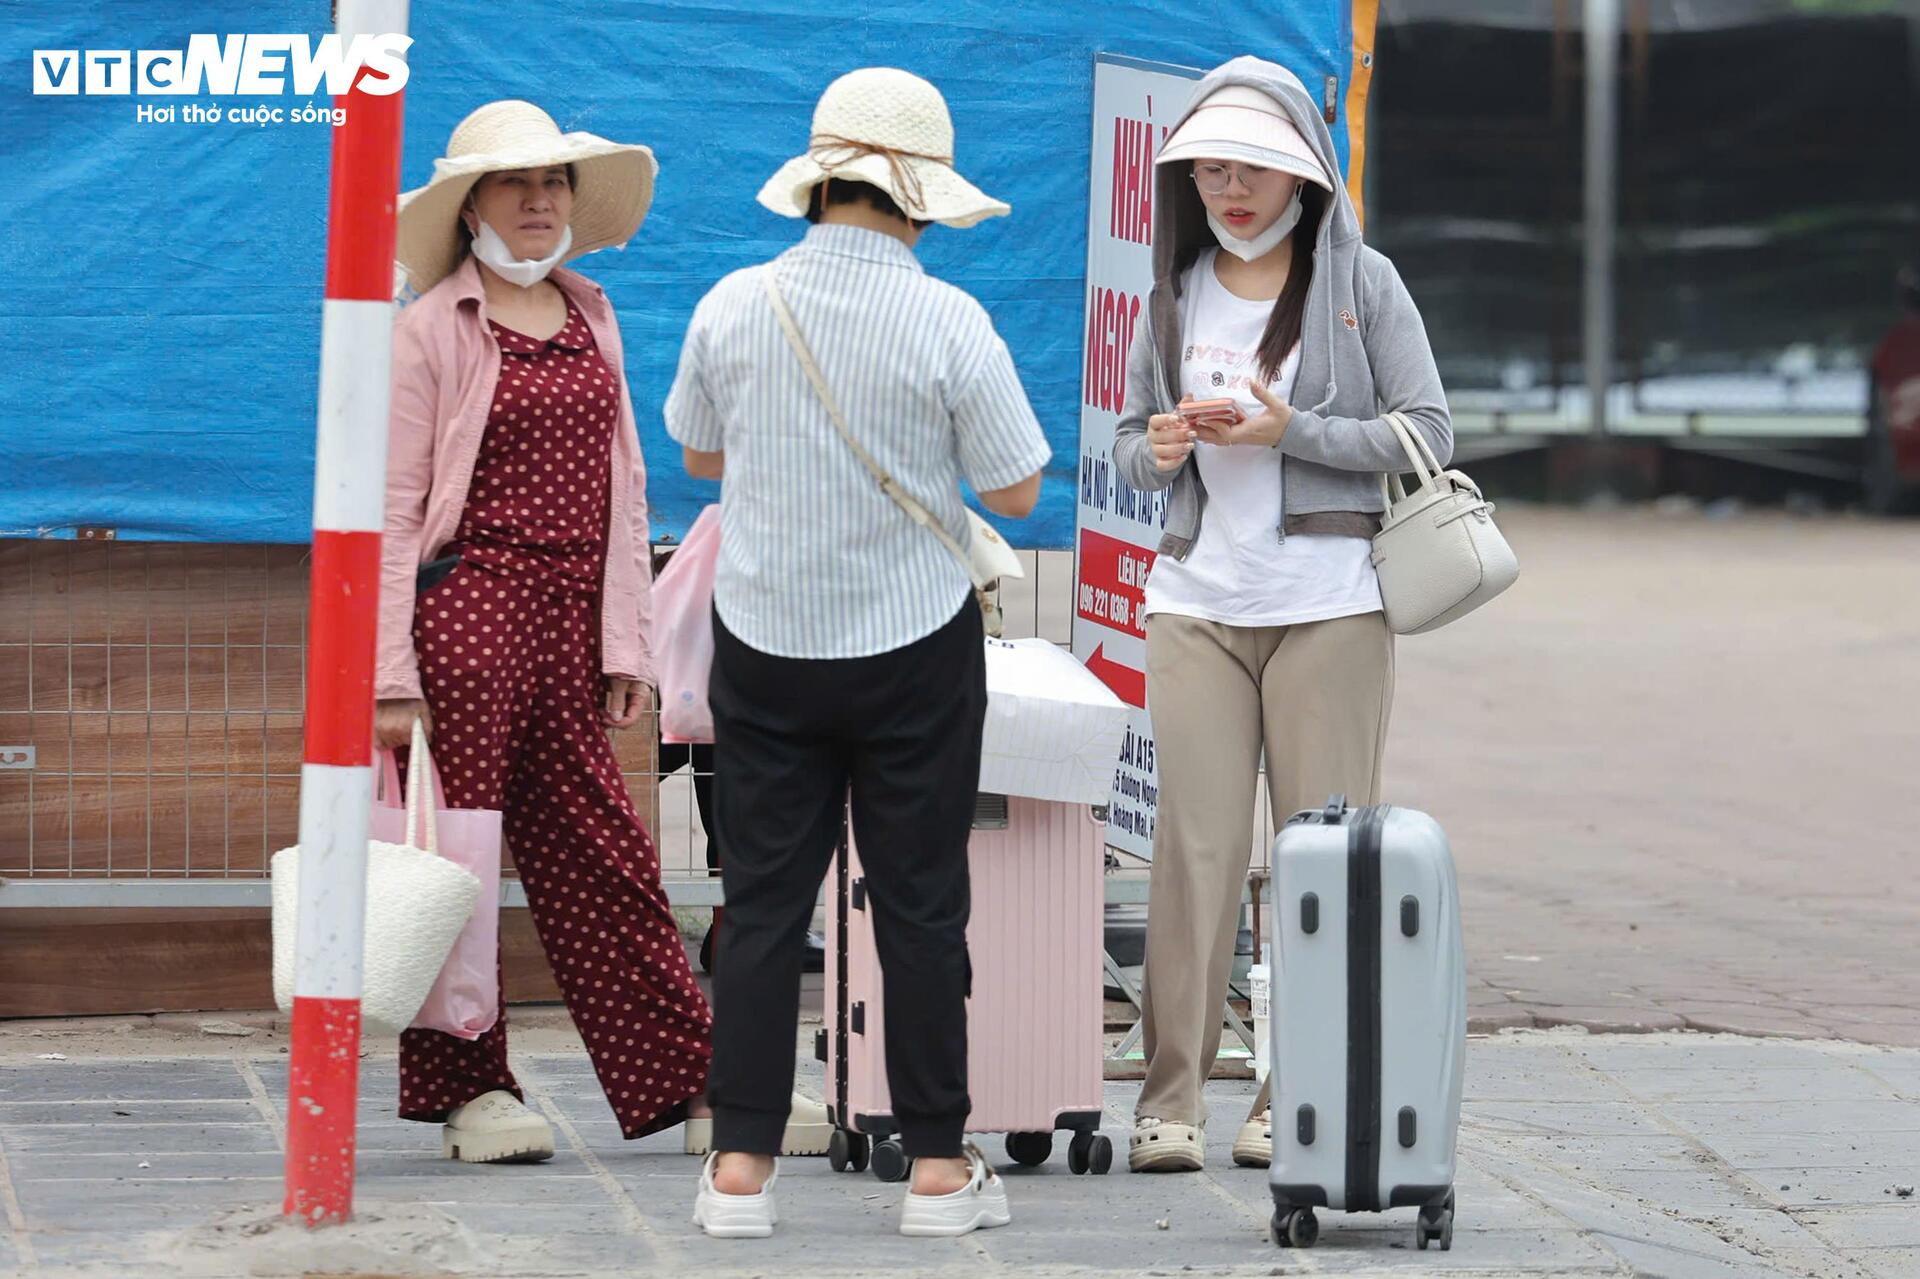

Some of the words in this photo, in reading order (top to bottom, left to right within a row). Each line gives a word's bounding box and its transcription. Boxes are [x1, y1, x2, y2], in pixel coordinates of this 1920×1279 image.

[1093, 450, 1109, 522] NỘI
[1118, 550, 1136, 587] LIÊN
[1080, 582, 1094, 614] 096
[1094, 587, 1108, 619] 221
[1135, 735, 1154, 774] A15
